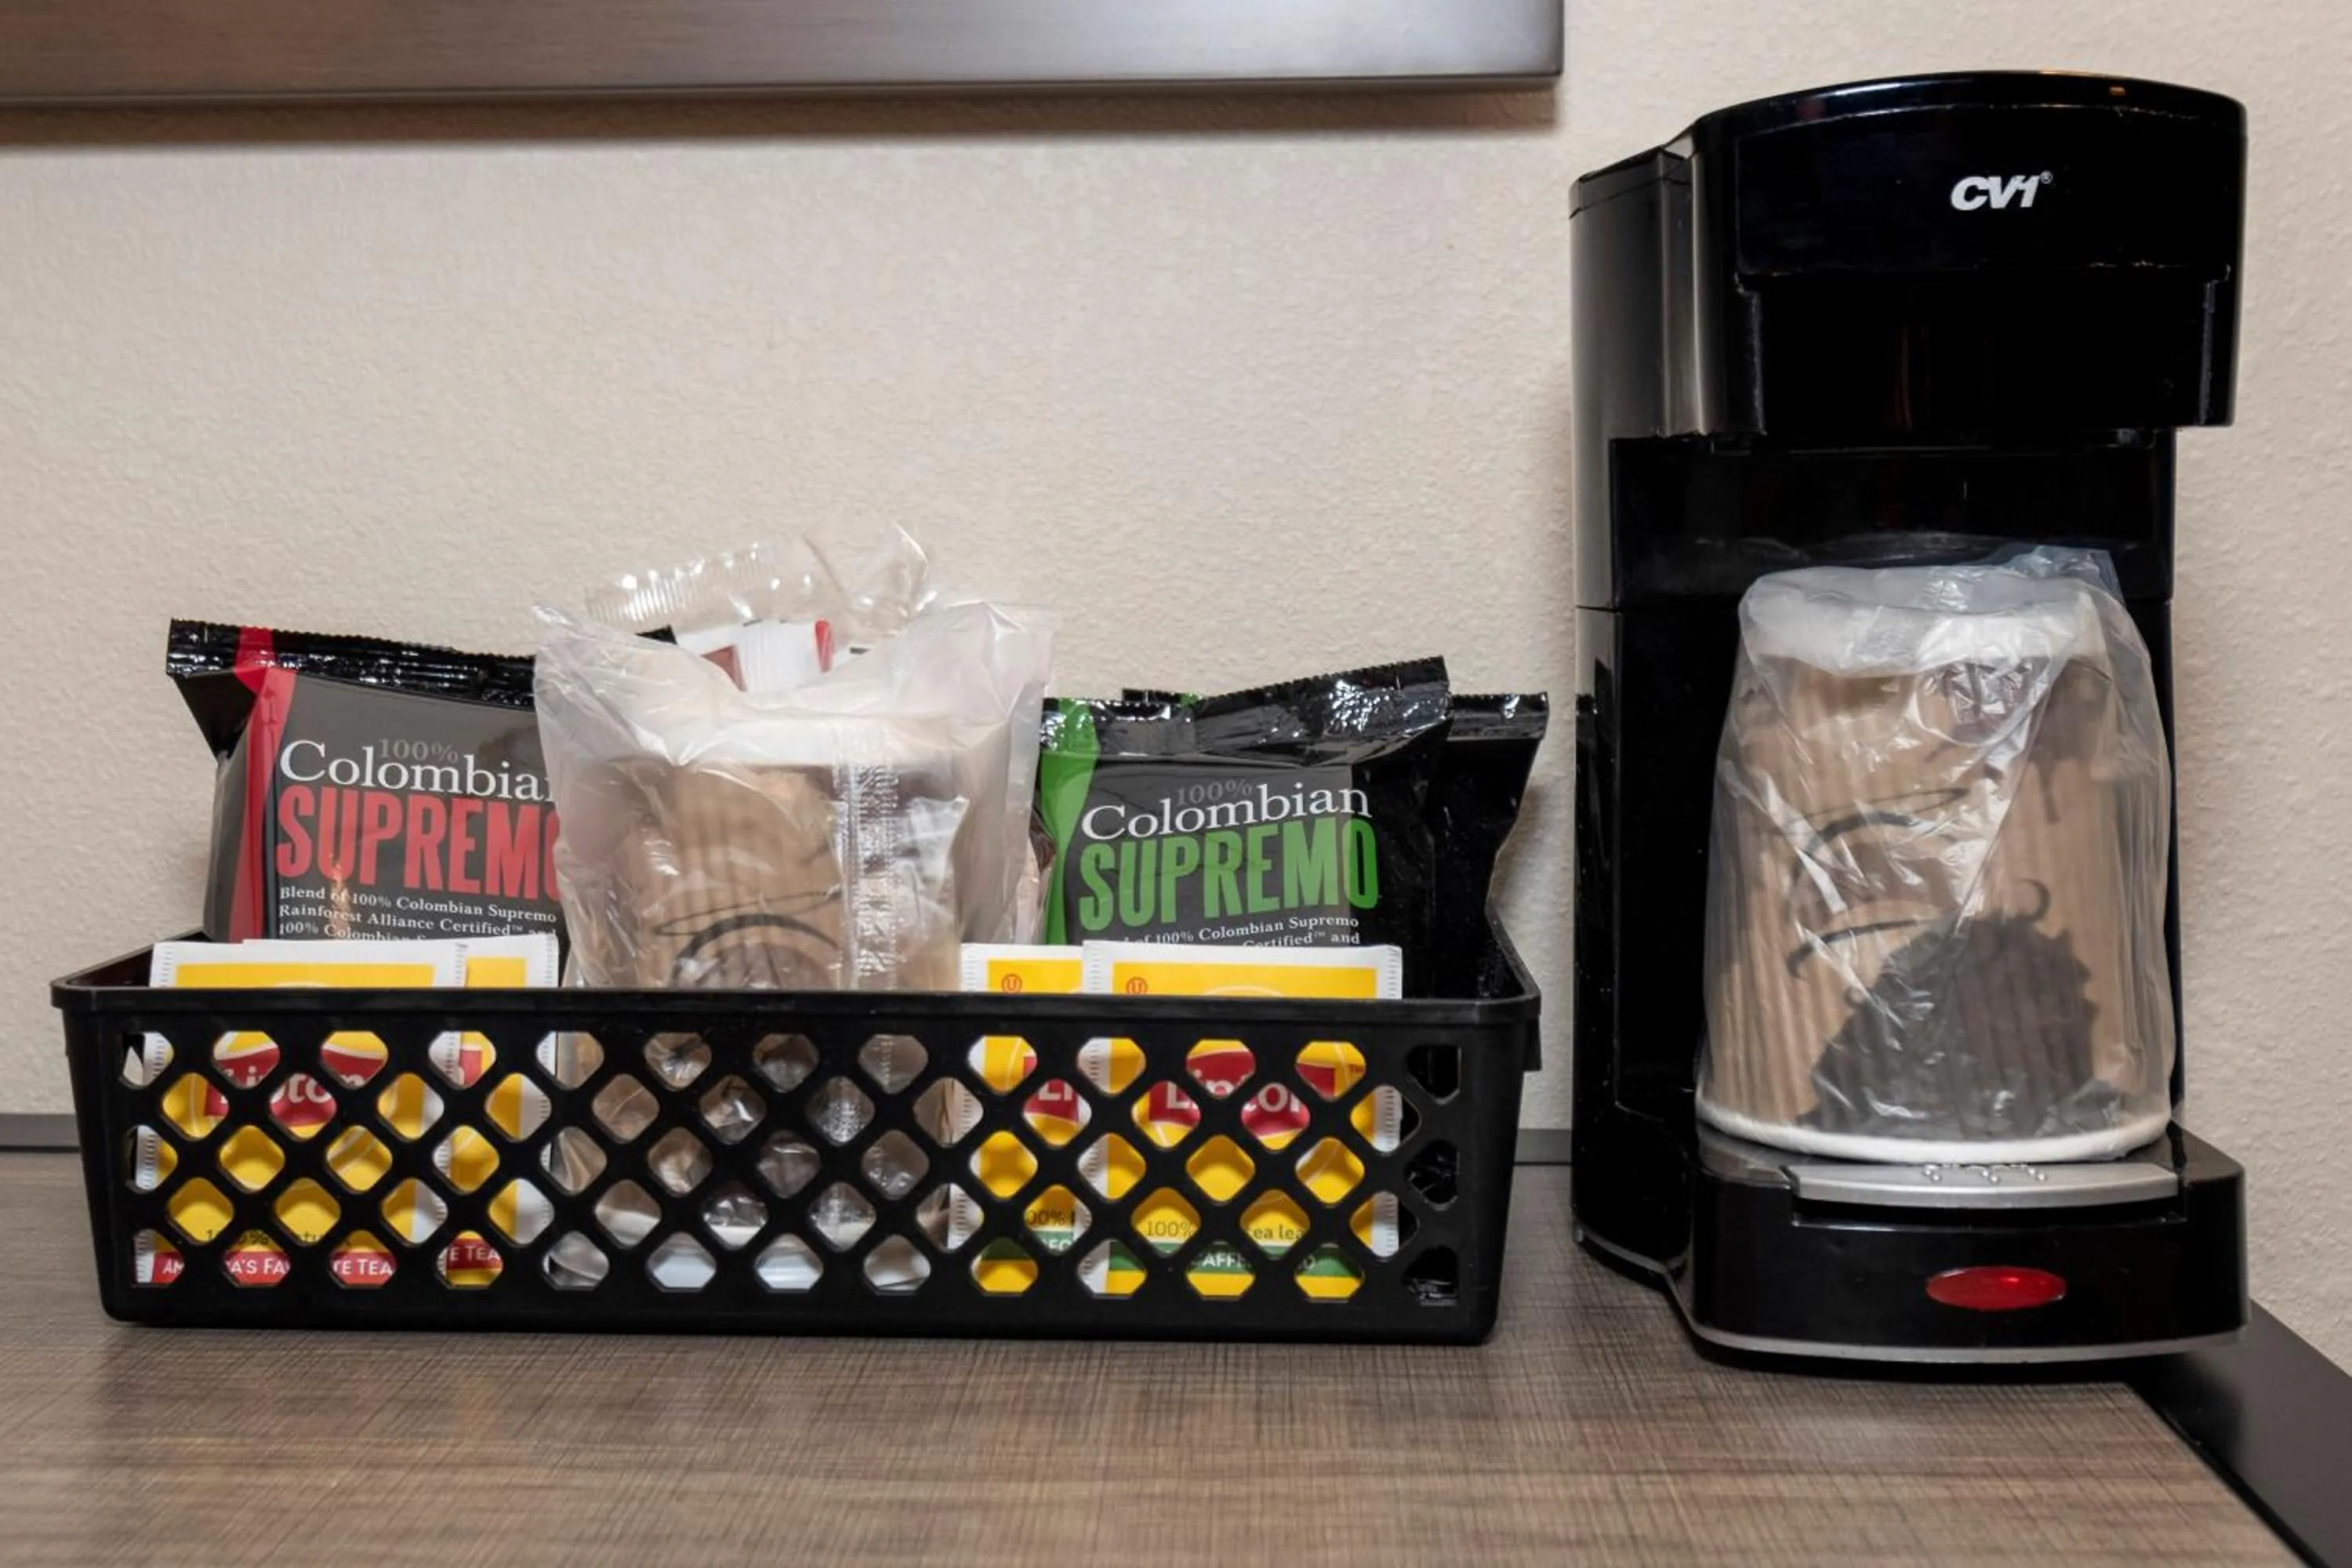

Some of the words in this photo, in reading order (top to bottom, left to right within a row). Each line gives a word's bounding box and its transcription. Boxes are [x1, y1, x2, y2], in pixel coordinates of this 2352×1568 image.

[378, 739, 458, 764] 100%
[280, 739, 554, 802] Colombia
[1178, 778, 1254, 807] 100%
[1082, 782, 1372, 840] Colombian
[1079, 817, 1380, 931] SUPREMO
[279, 904, 362, 923] Rainforest
[367, 913, 434, 930] Alliance
[280, 886, 325, 900] Blend
[330, 887, 349, 902] of
[353, 893, 392, 909] 100%
[396, 896, 483, 916] Colombian
[488, 903, 557, 923] Supremo
[279, 921, 319, 935] 100%
[1199, 921, 1284, 941] Colombian
[1289, 915, 1359, 931] Supremo
[1330, 932, 1360, 945] and
